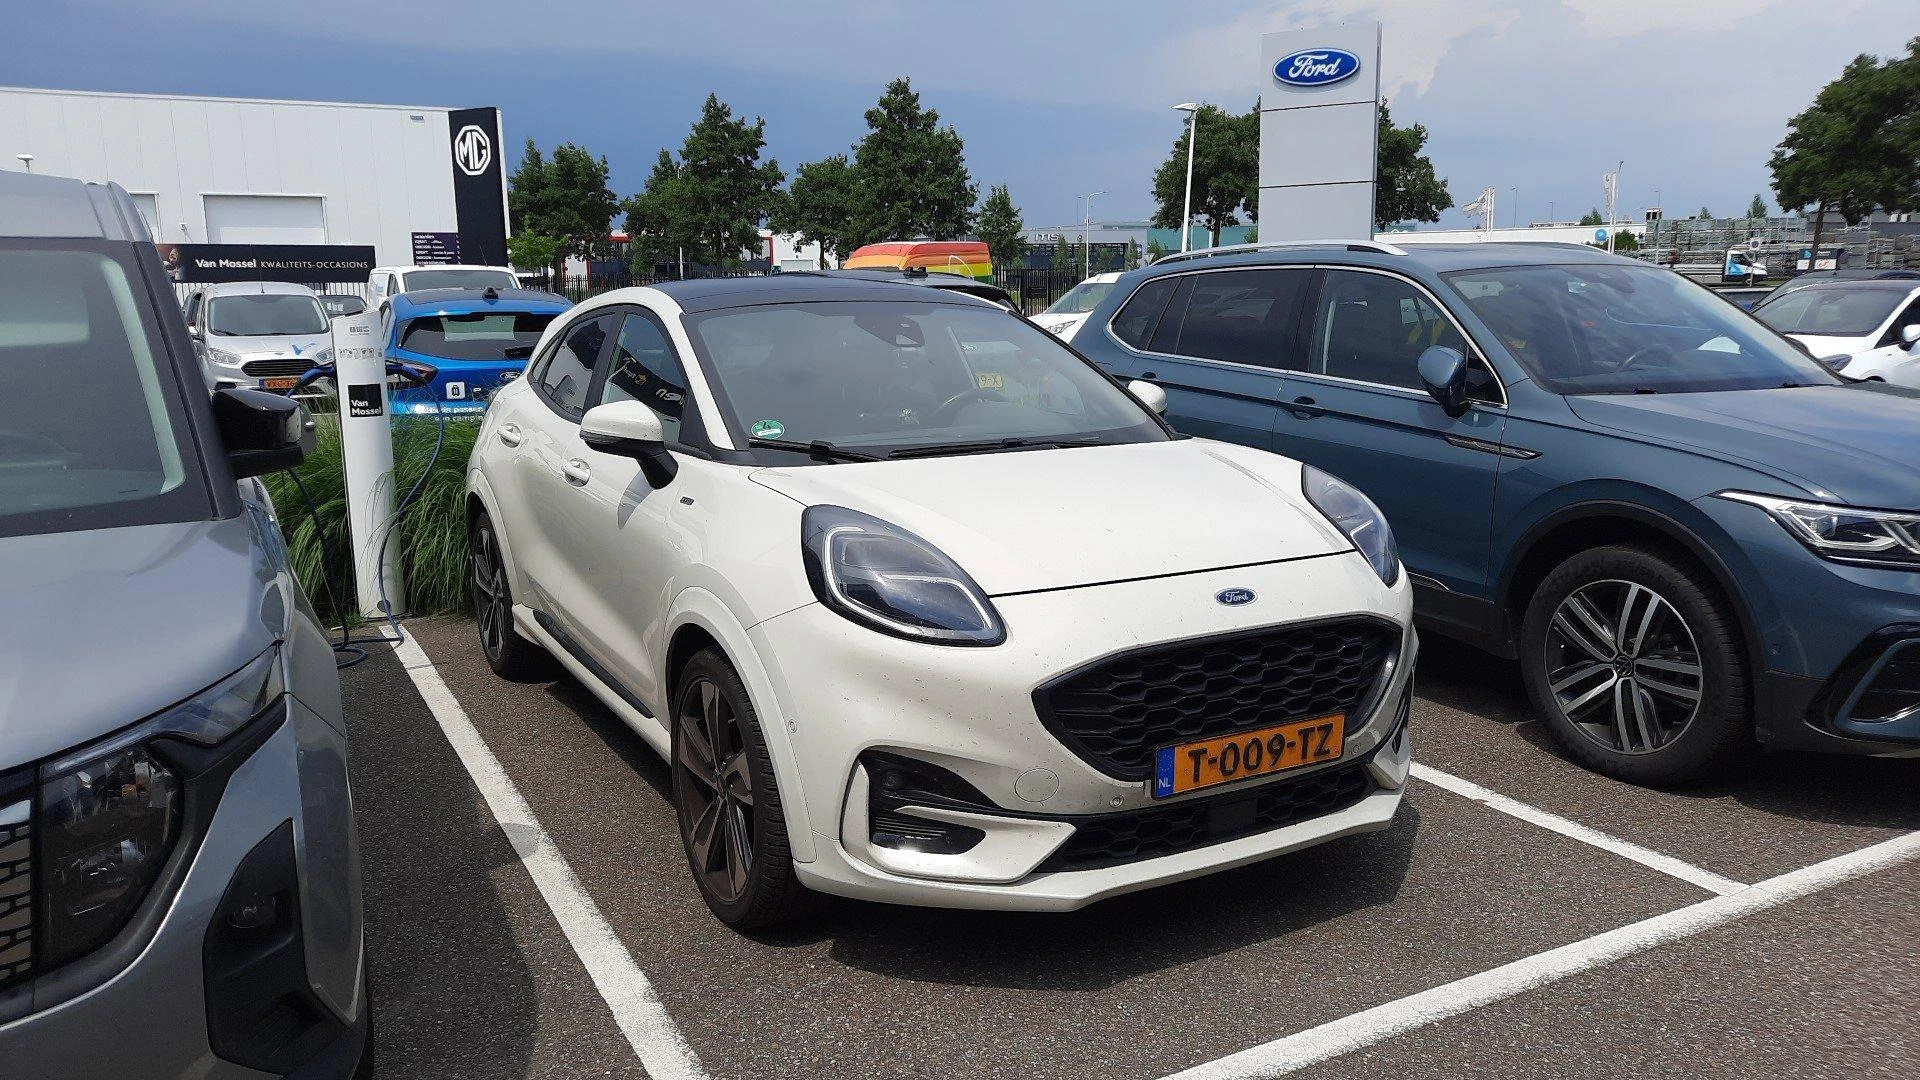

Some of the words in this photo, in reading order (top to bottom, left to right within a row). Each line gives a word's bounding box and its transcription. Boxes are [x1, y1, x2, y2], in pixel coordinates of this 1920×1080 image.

[1288, 54, 1342, 79] Ford
[458, 130, 488, 171] MG
[195, 258, 217, 268] Van
[219, 258, 258, 269] Mossel
[260, 260, 369, 269] KWALITEITS-OCCASIONS
[351, 399, 369, 407] Van
[352, 406, 382, 416] Mossel
[1225, 590, 1250, 603] Ford
[1187, 722, 1334, 784] T-009-TZ
[1158, 777, 1172, 789] NL
